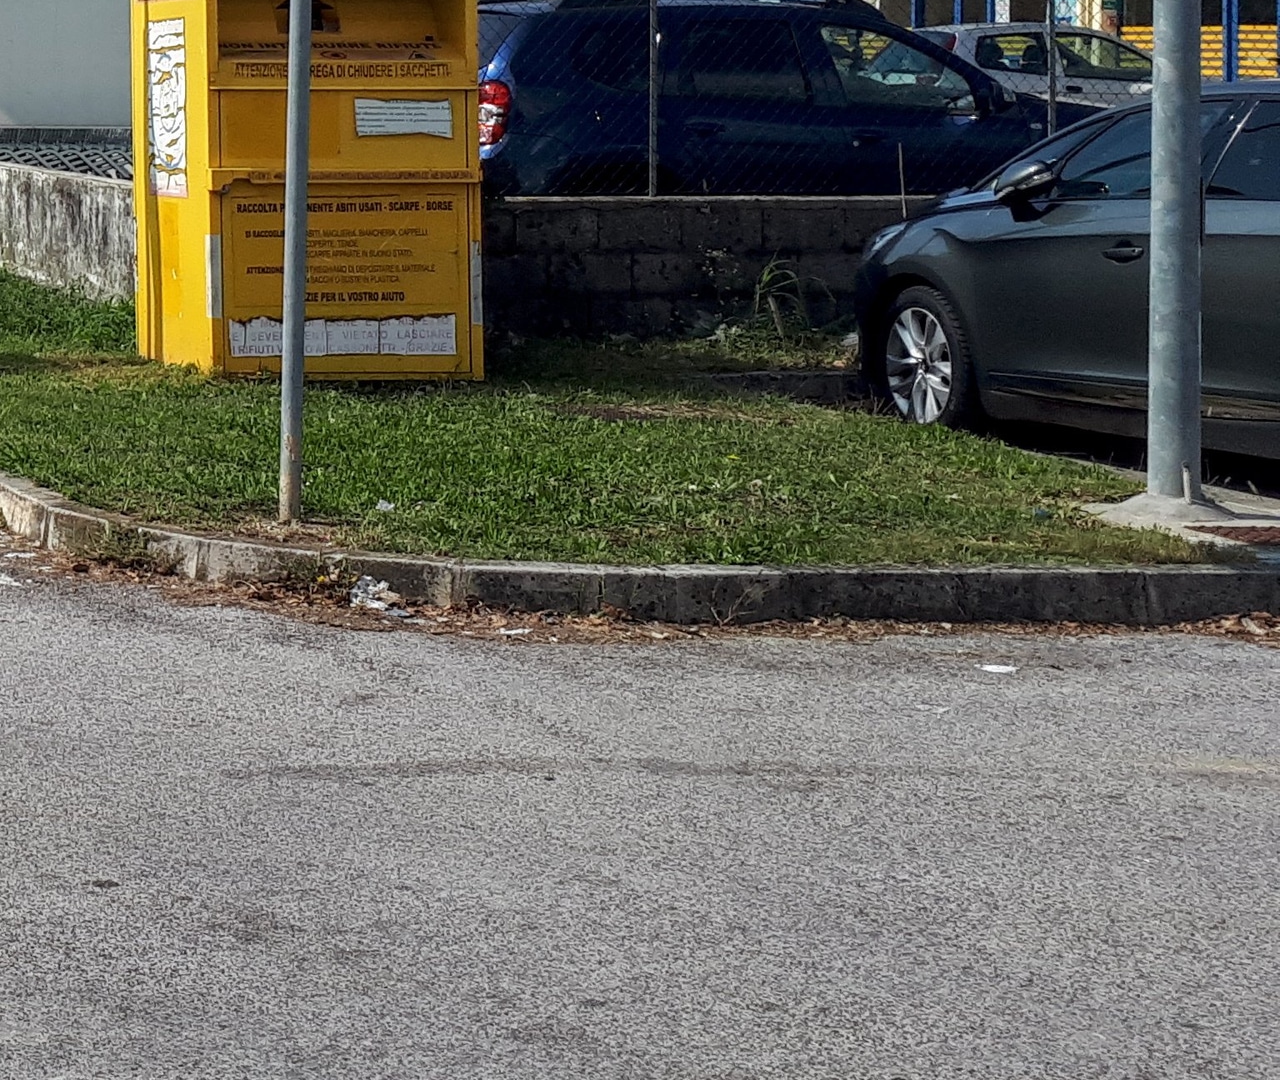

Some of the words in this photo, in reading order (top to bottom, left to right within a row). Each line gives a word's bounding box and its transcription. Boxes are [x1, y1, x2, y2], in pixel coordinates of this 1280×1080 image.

[234, 63, 288, 78] ATTENZIONE
[309, 63, 335, 78] REGA
[336, 64, 345, 78] DI
[347, 63, 392, 78] CHIUDERE
[236, 203, 278, 213] RACCOLTA
[280, 202, 333, 213] PNENTE
[335, 202, 357, 213] ABITI
[358, 201, 382, 212] USATI
[389, 201, 420, 211] SCARPE
[426, 200, 453, 211] BORSE
[320, 292, 336, 302] PER
[338, 292, 346, 302] IL
[347, 291, 379, 302] VOSTRO
[381, 291, 405, 302] AIUTO
